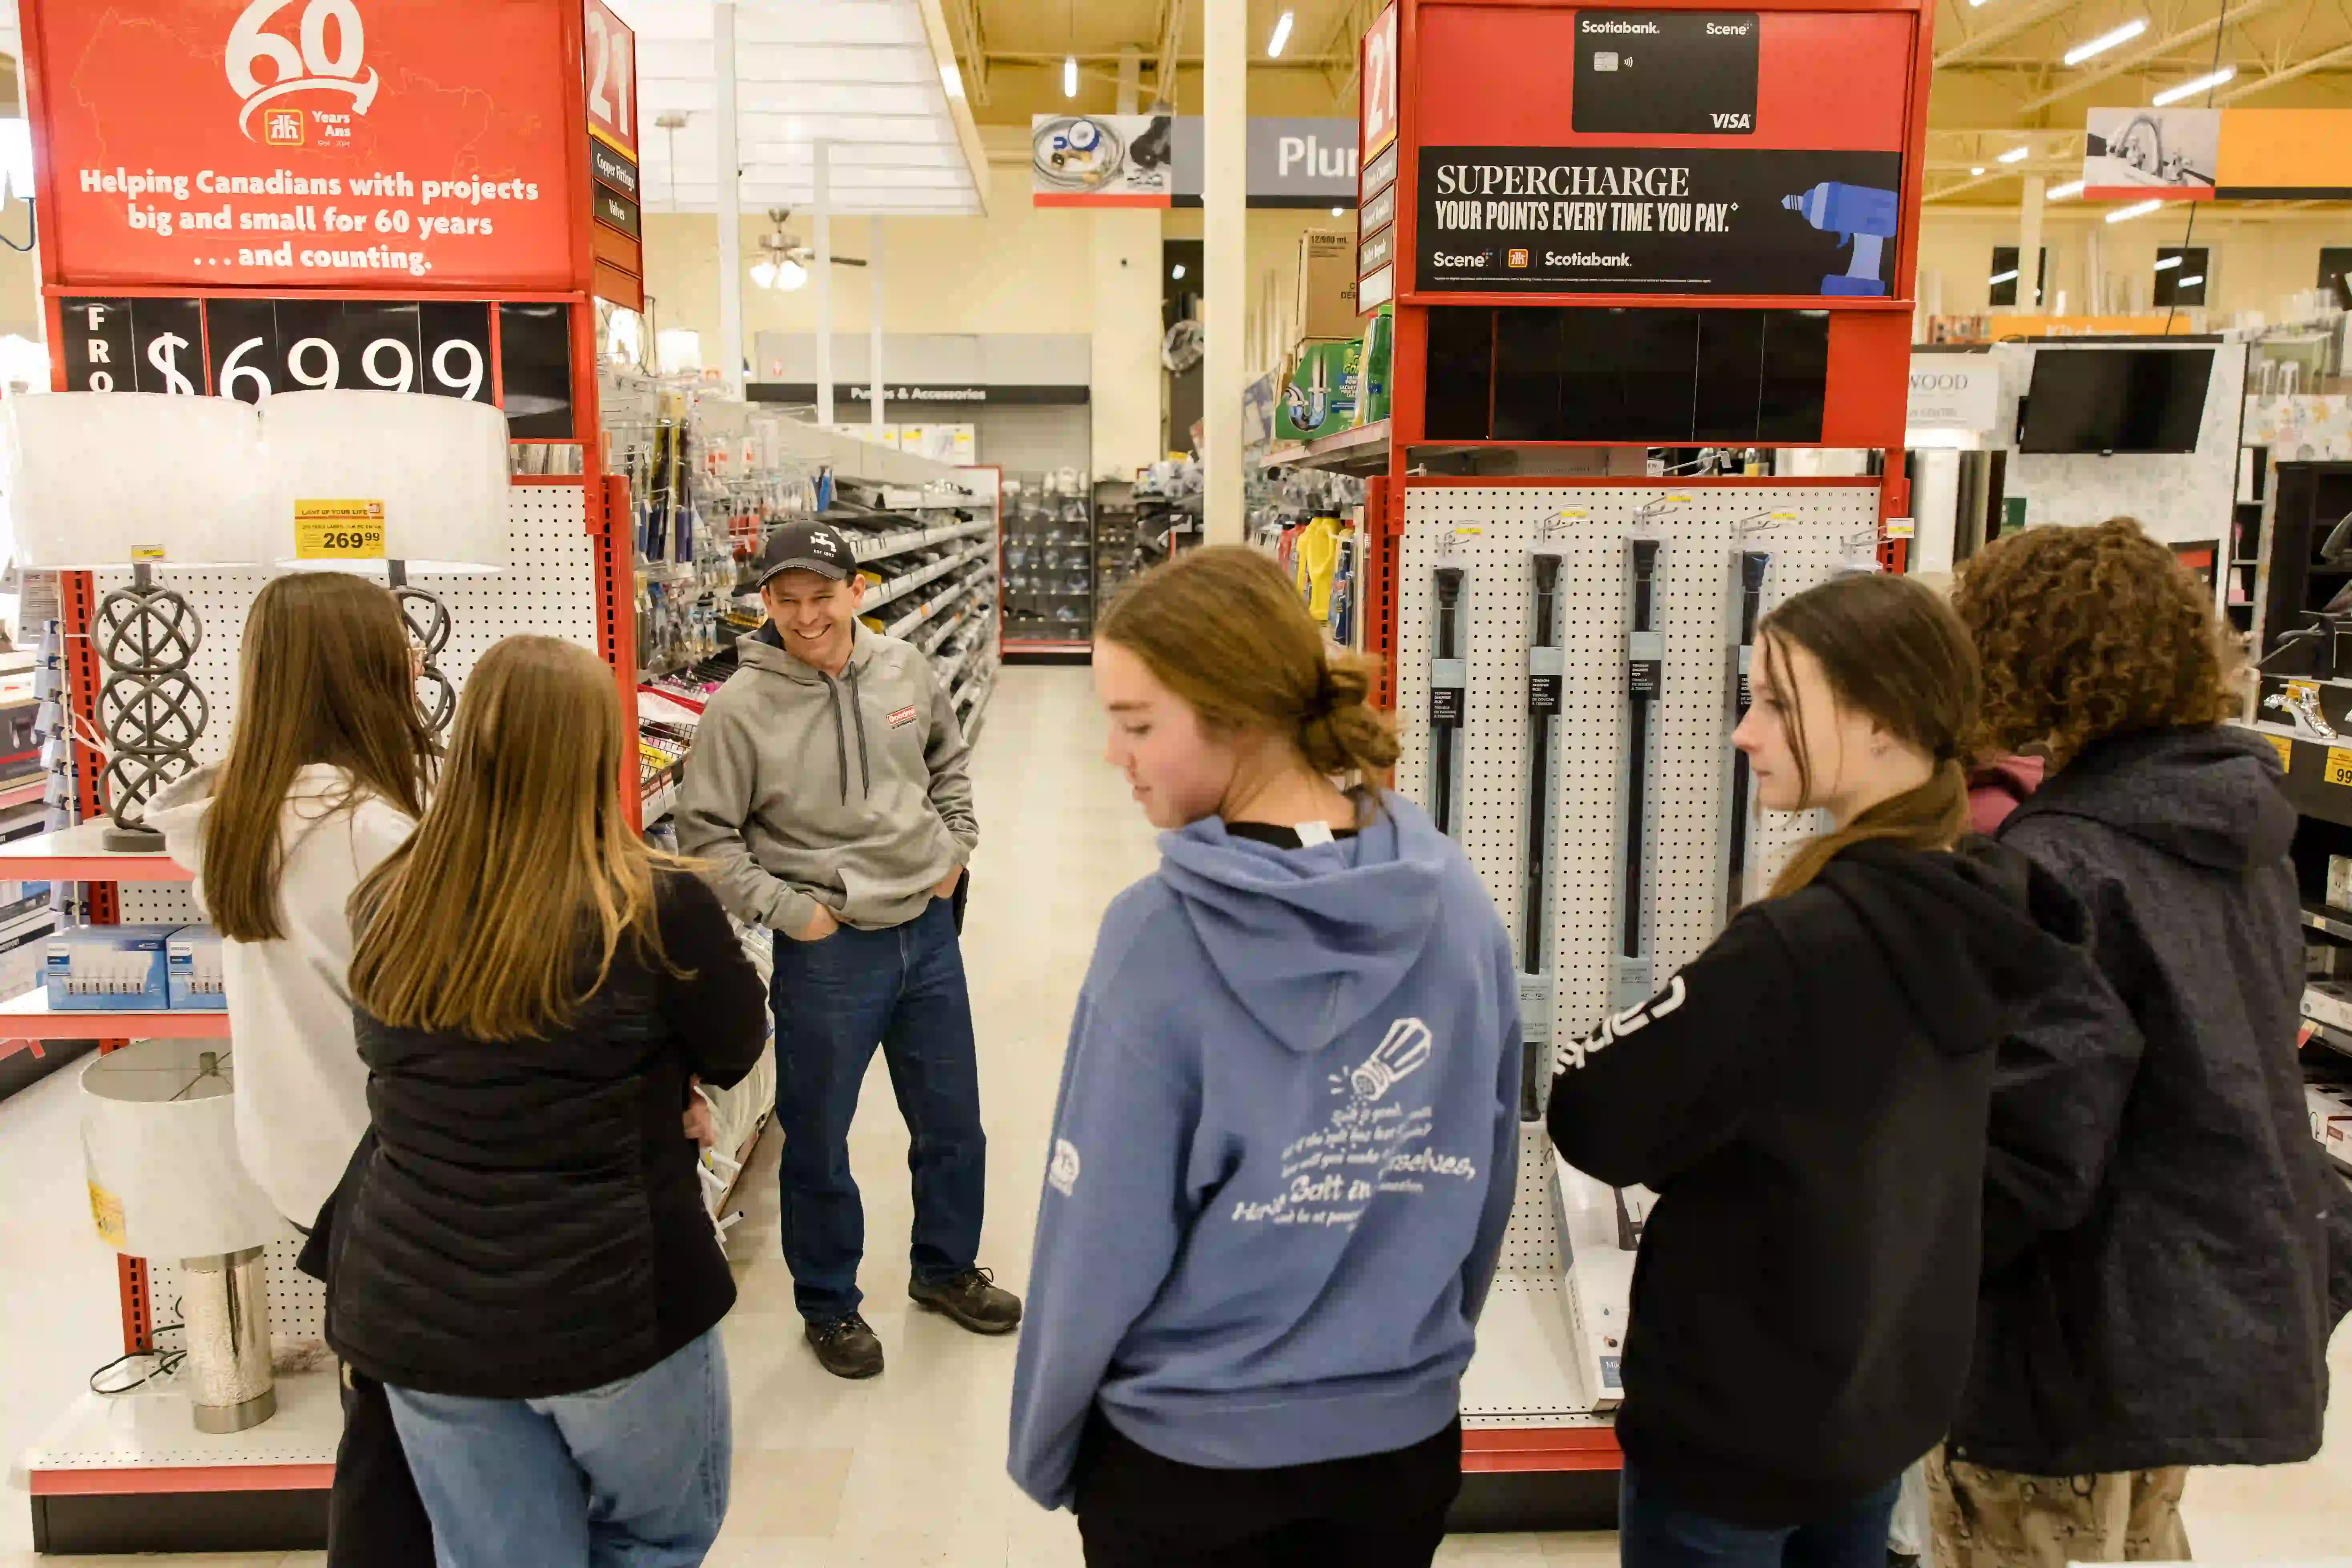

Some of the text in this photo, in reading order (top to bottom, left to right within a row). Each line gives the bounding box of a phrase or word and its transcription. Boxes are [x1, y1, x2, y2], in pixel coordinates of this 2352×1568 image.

[225, 0, 364, 100] 60
[589, 11, 628, 137] 21
[1367, 6, 1396, 140] 21
[311, 110, 350, 123] Years
[325, 124, 351, 137] Ans
[1709, 113, 1751, 128] VISA
[80, 167, 538, 205] Helping Canadians with projects
[597, 153, 634, 192] Copper Fittings
[1437, 165, 1689, 197] SUPERCHARGE
[128, 204, 493, 240] big and small for 60 years
[609, 199, 625, 221] Valves
[1436, 201, 1482, 230] YOUR
[1486, 201, 1549, 231] POINTS
[1553, 202, 1606, 231] EVERY
[1611, 203, 1653, 232] TIME
[1657, 203, 1691, 232] YOU
[300, 245, 432, 276] counting.
[88, 307, 113, 391] FRO
[897, 387, 909, 400] &
[911, 387, 986, 400] Accessories
[323, 532, 363, 548] 269
